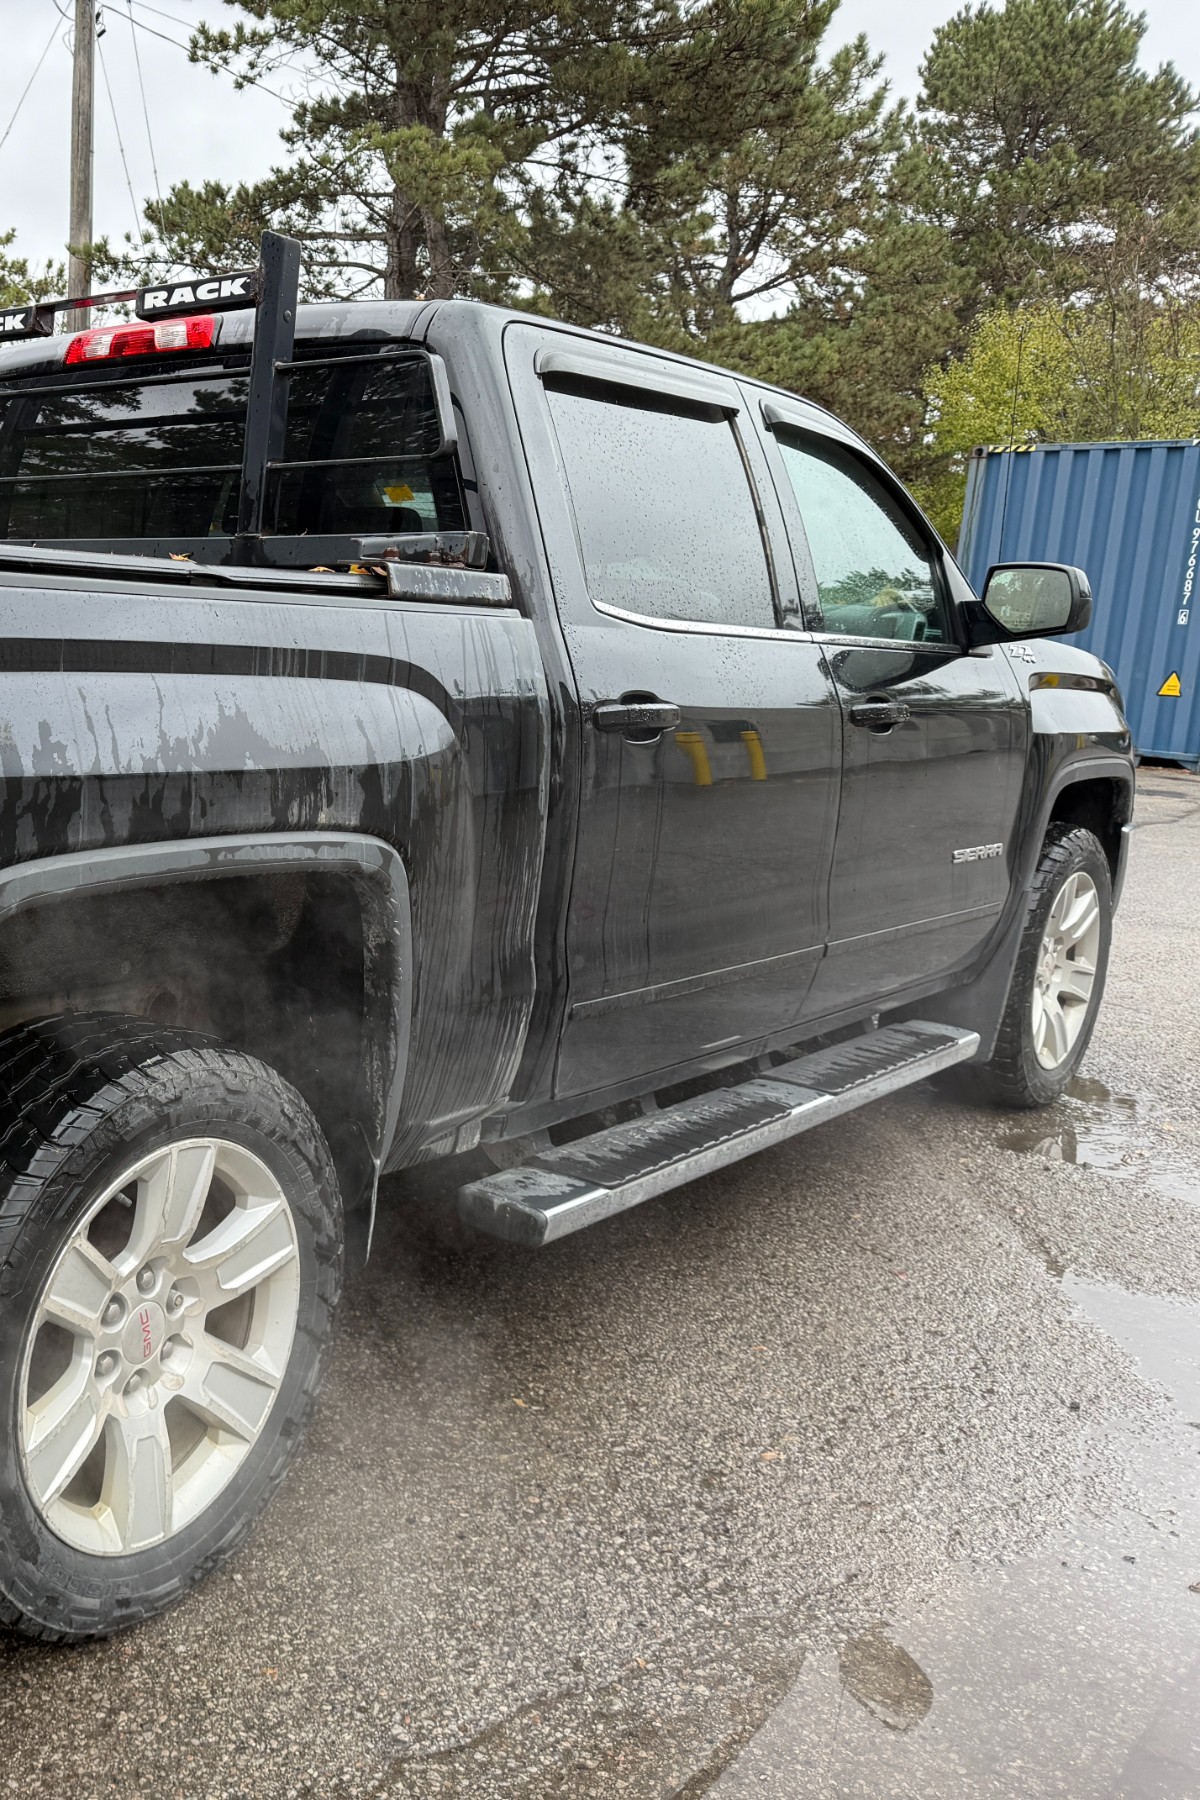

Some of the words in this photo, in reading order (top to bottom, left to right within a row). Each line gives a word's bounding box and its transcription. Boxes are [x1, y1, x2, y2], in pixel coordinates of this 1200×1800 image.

[144, 277, 249, 309] RACK
[952, 842, 1003, 864] SIERRA
[139, 1309, 151, 1358] GMC
